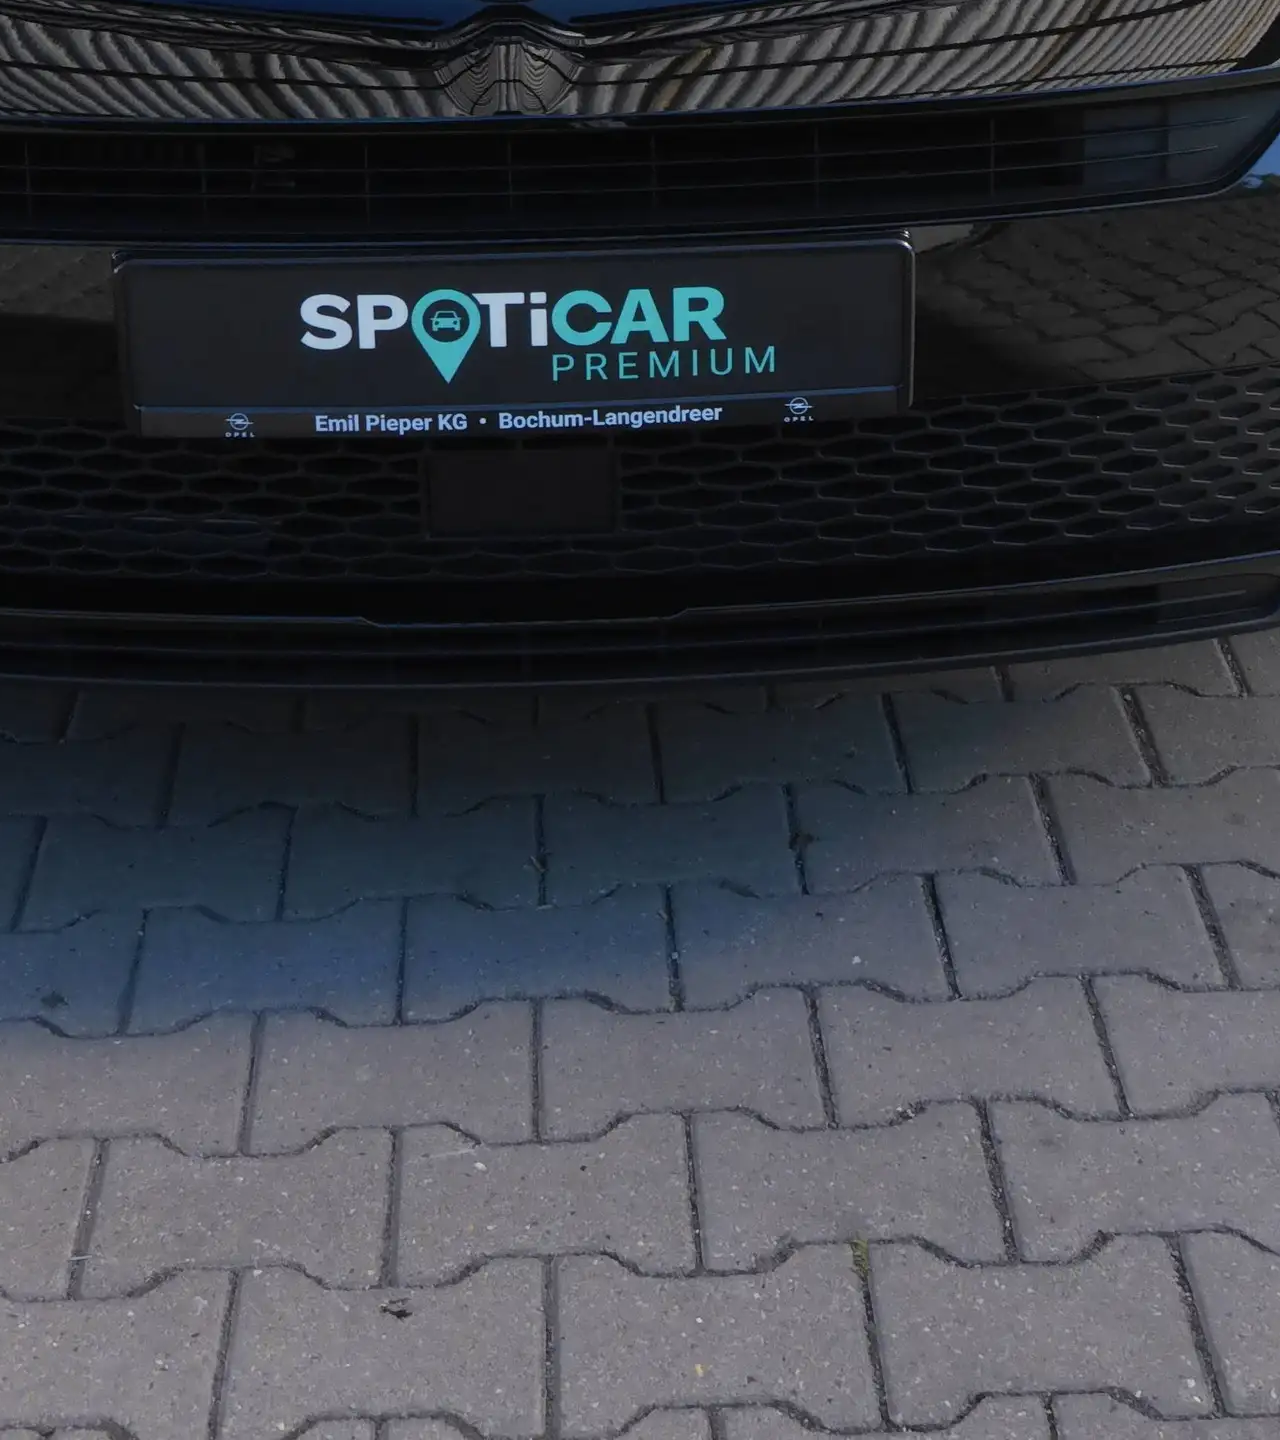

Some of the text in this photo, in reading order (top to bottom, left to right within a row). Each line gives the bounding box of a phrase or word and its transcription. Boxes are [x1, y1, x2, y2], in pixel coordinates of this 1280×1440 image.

[552, 345, 775, 381] PREMIUM
[315, 405, 723, 436] Emil Pieper KG Bochum-Langendreer
[783, 415, 814, 423] OPEL
